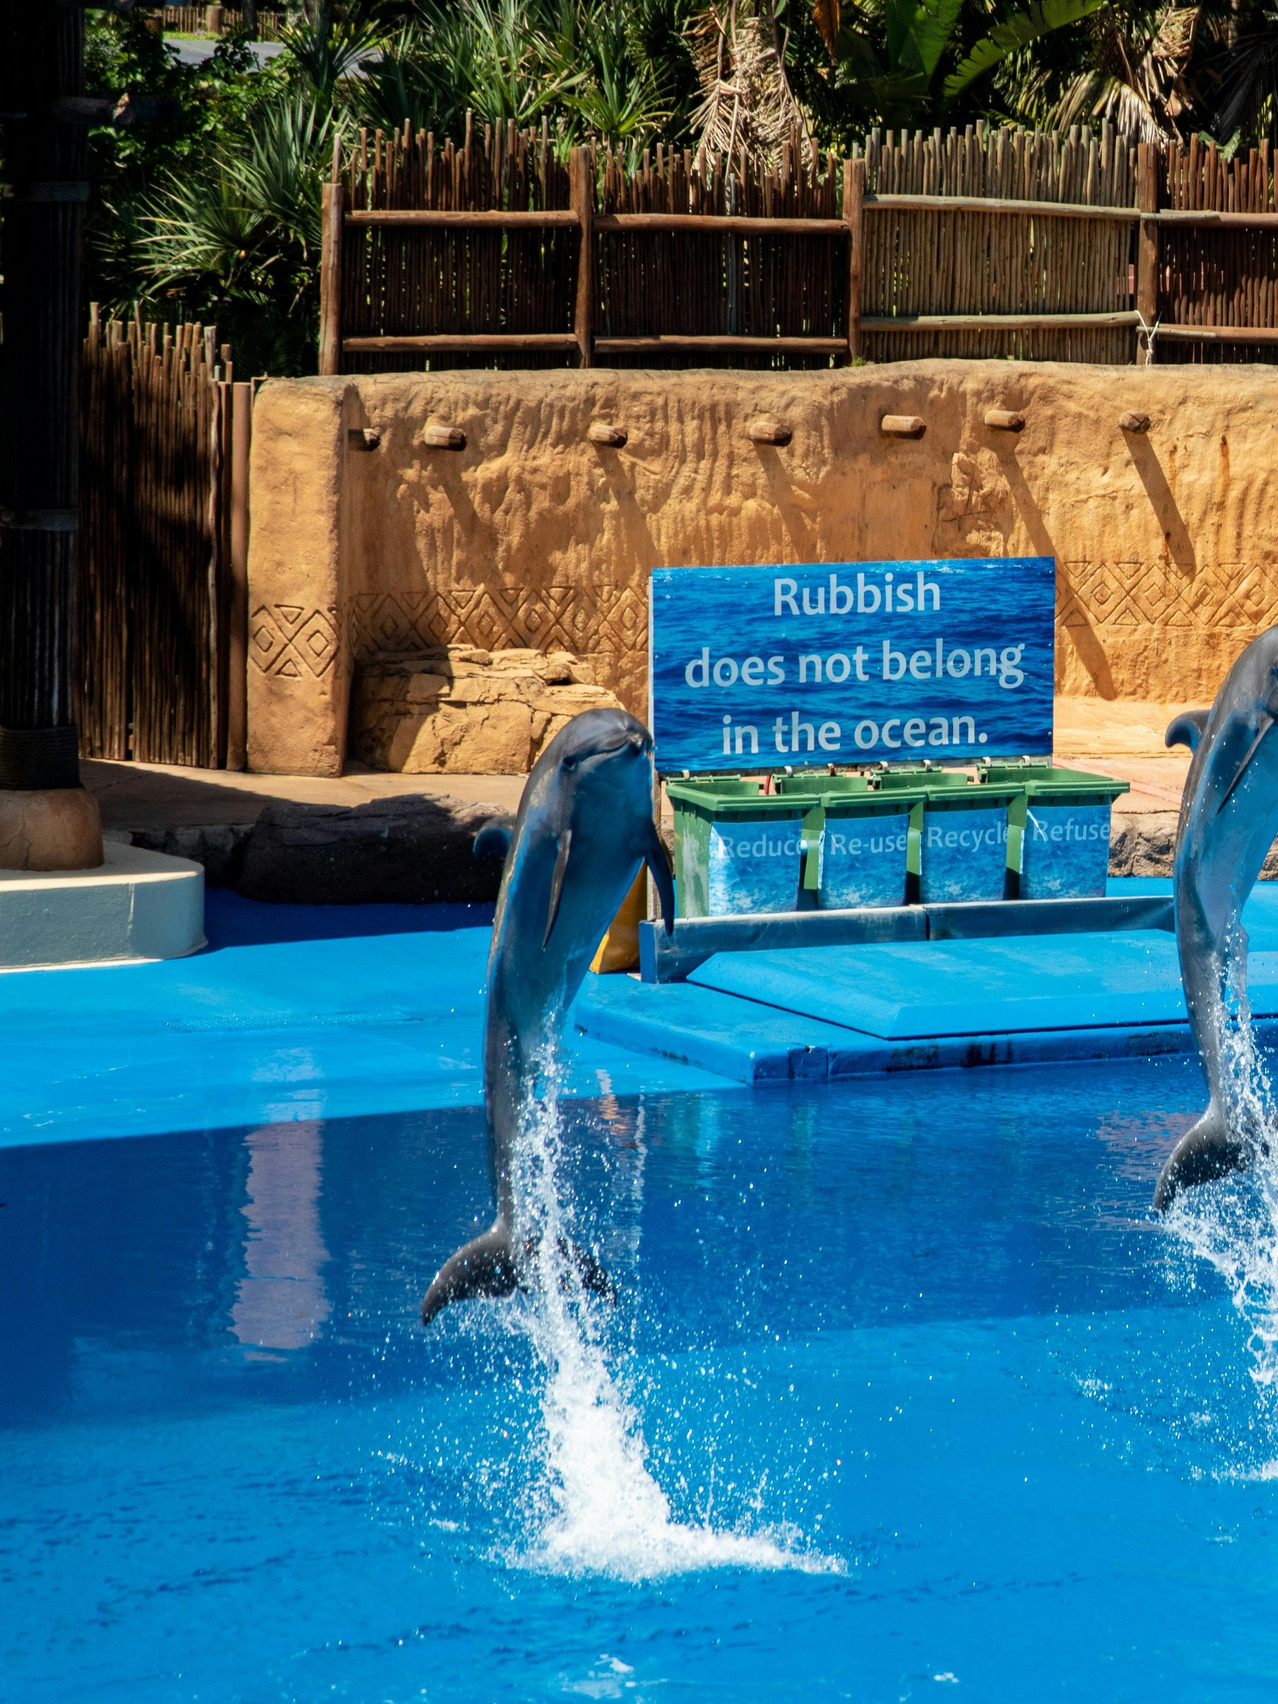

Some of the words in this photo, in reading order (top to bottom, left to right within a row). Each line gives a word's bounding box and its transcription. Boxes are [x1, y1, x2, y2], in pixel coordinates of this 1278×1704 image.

[773, 571, 941, 617] Rubbish
[685, 646, 785, 688] does
[799, 645, 870, 684] not
[882, 638, 1026, 689] belong
[722, 714, 759, 755] in
[772, 711, 842, 754] the
[853, 714, 989, 750] ocean.
[830, 833, 908, 856] Re-use
[1033, 817, 1110, 842] Refuse
